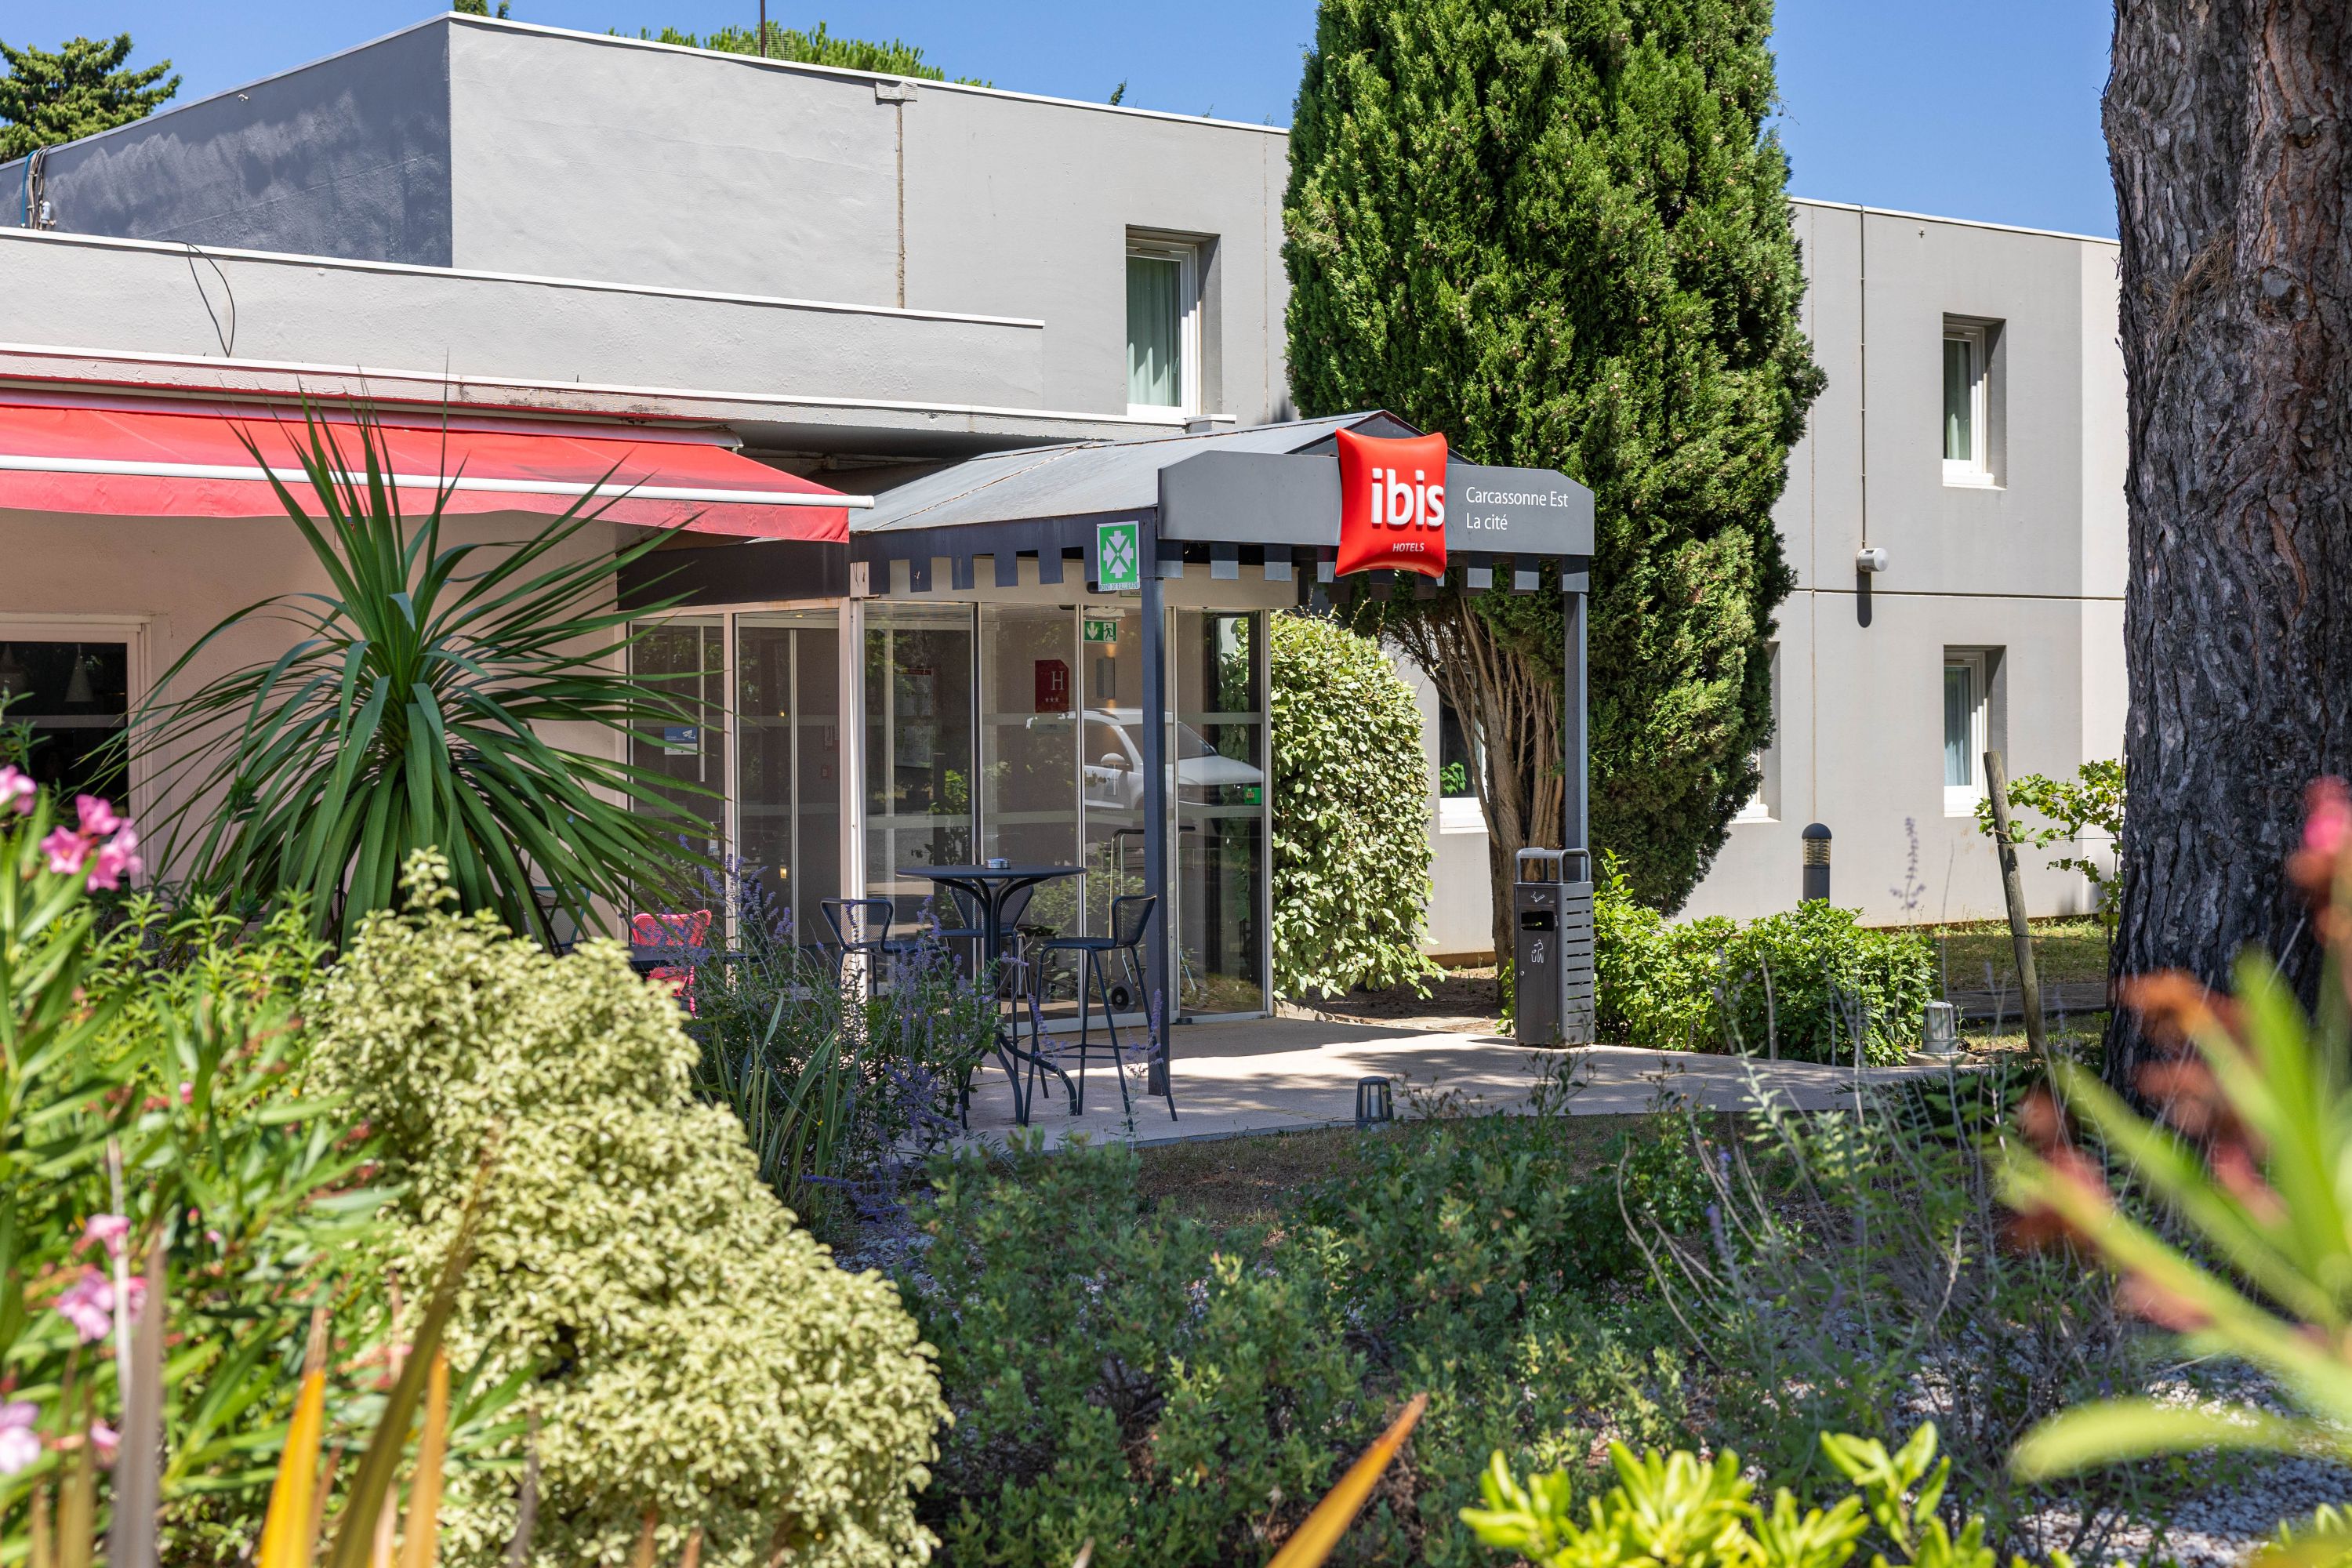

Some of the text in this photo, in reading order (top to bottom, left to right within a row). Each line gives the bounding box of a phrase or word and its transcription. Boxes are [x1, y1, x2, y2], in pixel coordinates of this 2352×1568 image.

[1371, 468, 1445, 527] ibis
[1466, 487, 1569, 507] Carcassonne Est
[1466, 512, 1508, 530] La cité
[1392, 543, 1425, 552] HOTELS
[1051, 670, 1065, 691] H
